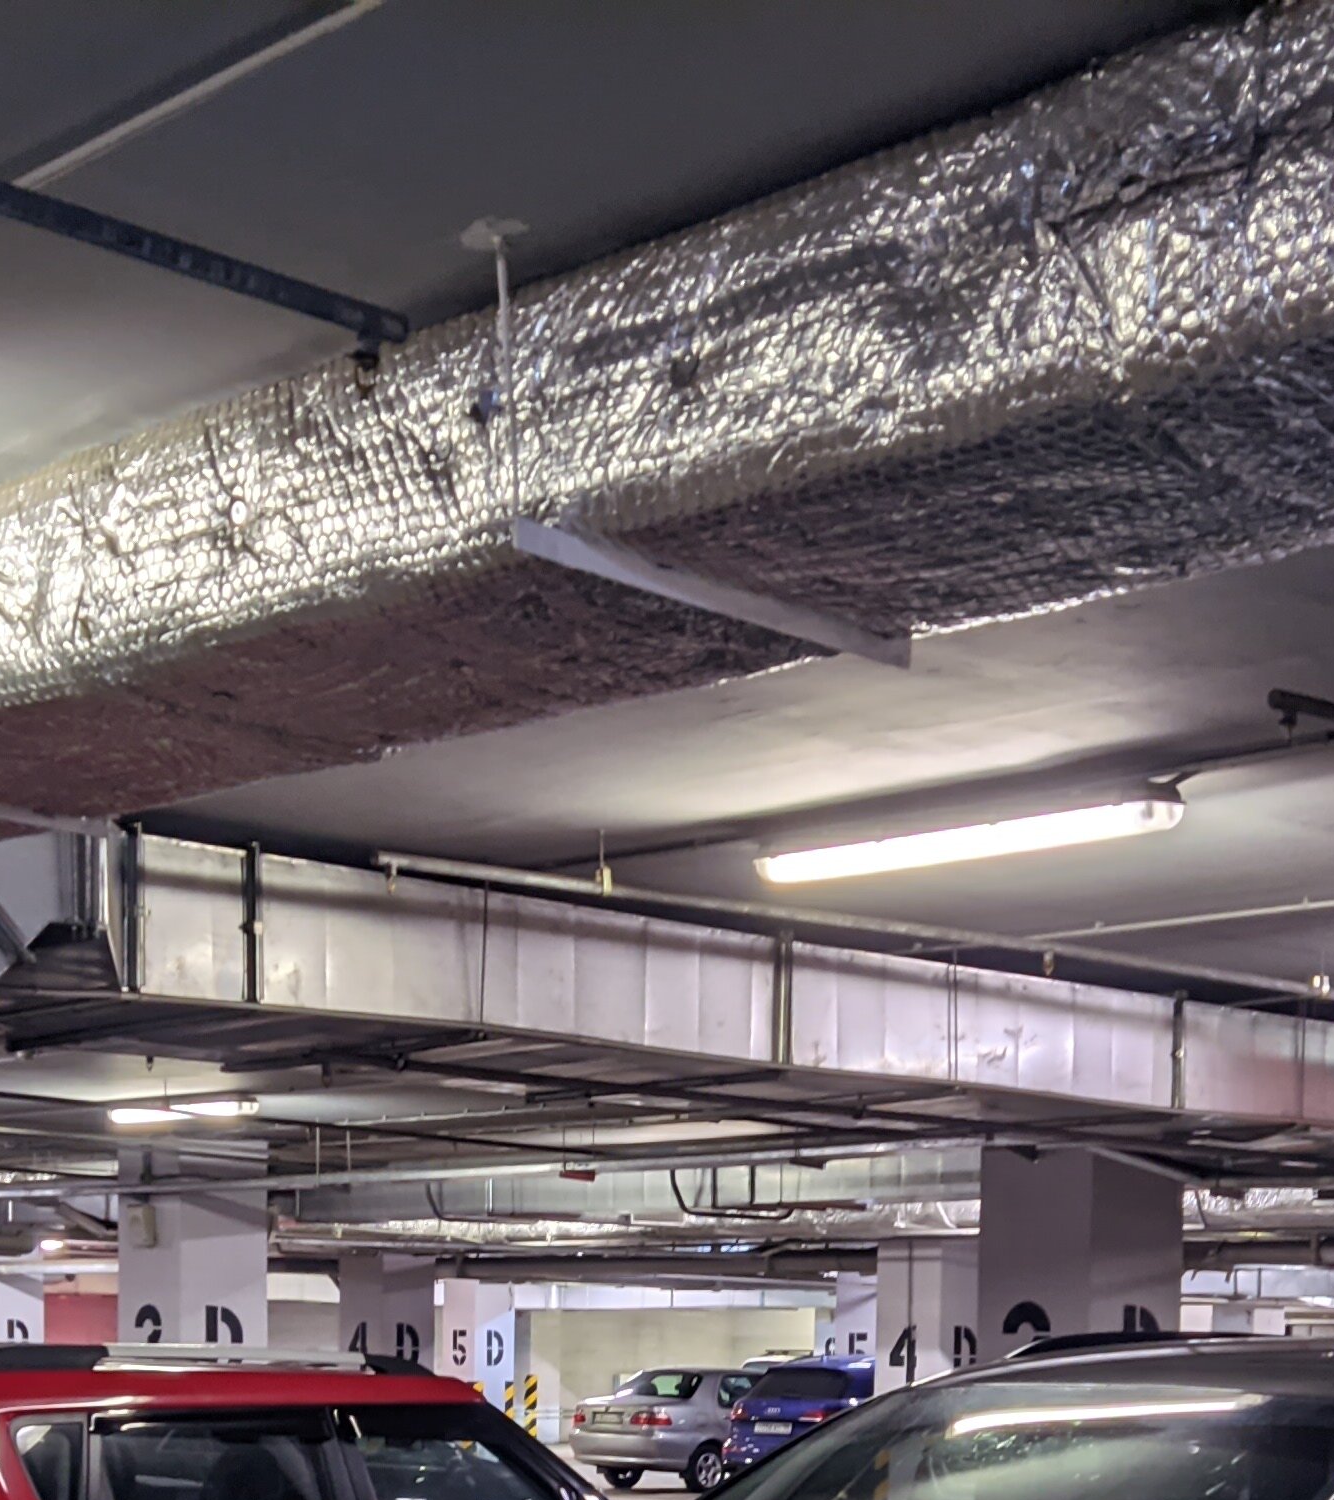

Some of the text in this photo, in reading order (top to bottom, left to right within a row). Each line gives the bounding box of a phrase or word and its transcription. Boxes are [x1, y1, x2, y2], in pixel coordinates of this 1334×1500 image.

[396, 1322, 420, 1362] D
[452, 1329, 504, 1366] 5 D
[889, 1324, 917, 1384] 4
